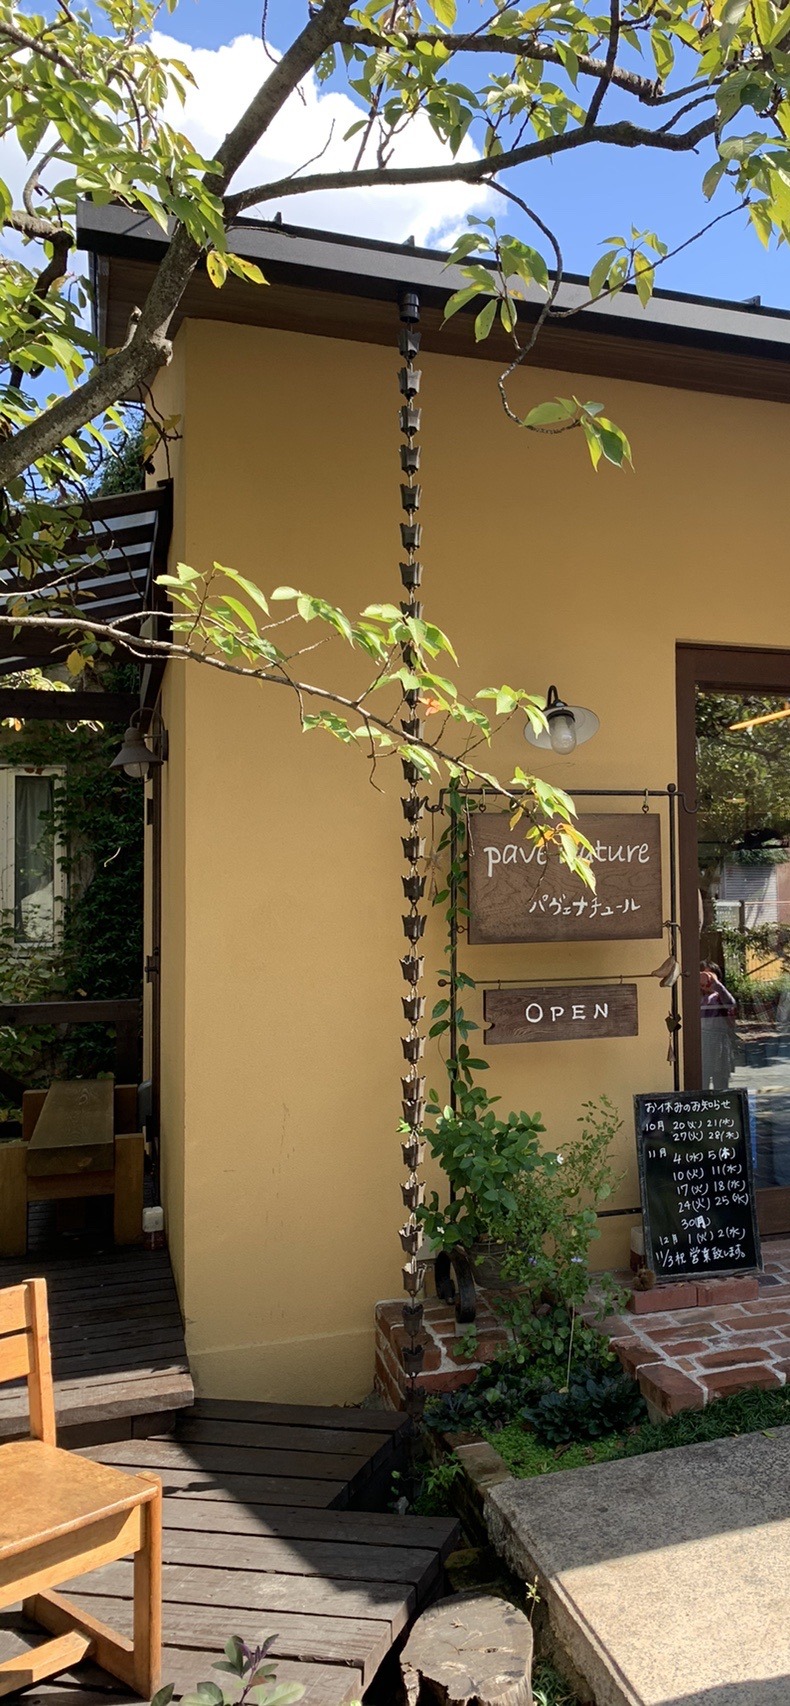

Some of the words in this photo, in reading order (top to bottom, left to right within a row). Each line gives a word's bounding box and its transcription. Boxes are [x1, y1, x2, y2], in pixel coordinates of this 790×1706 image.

[529, 894, 641, 918] パヴェナチュール
[525, 1002, 609, 1023] OPEN
[644, 1099, 731, 1114] お休みのお知らせ
